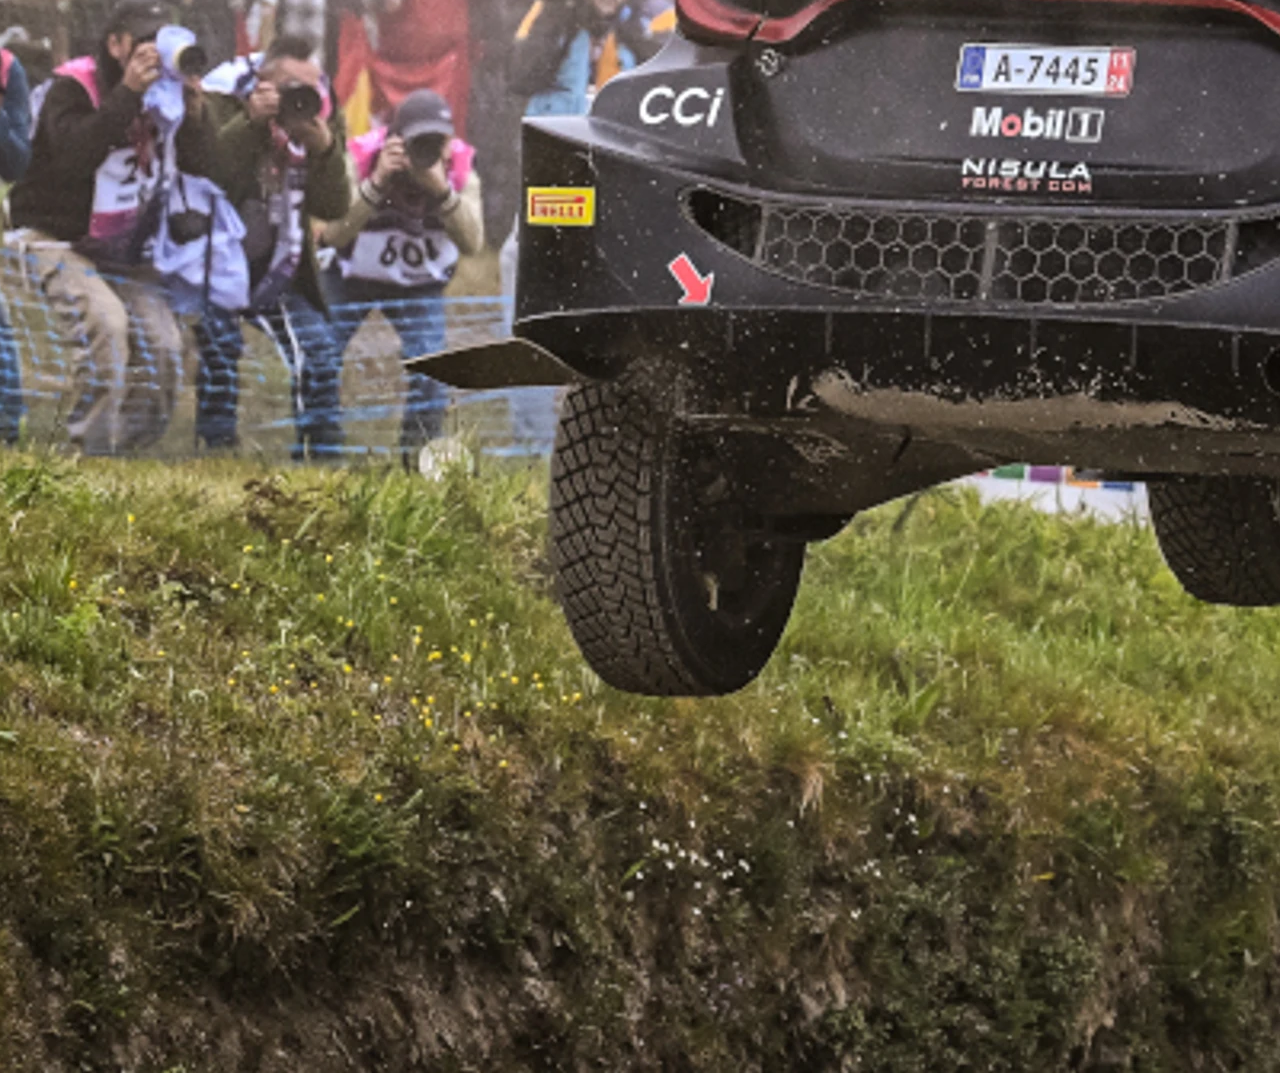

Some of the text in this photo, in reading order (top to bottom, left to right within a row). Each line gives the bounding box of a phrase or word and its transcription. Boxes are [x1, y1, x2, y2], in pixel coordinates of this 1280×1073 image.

[991, 54, 1099, 85] A-7445
[970, 106, 1066, 140] Mobil
[961, 157, 1091, 180] NISULA
